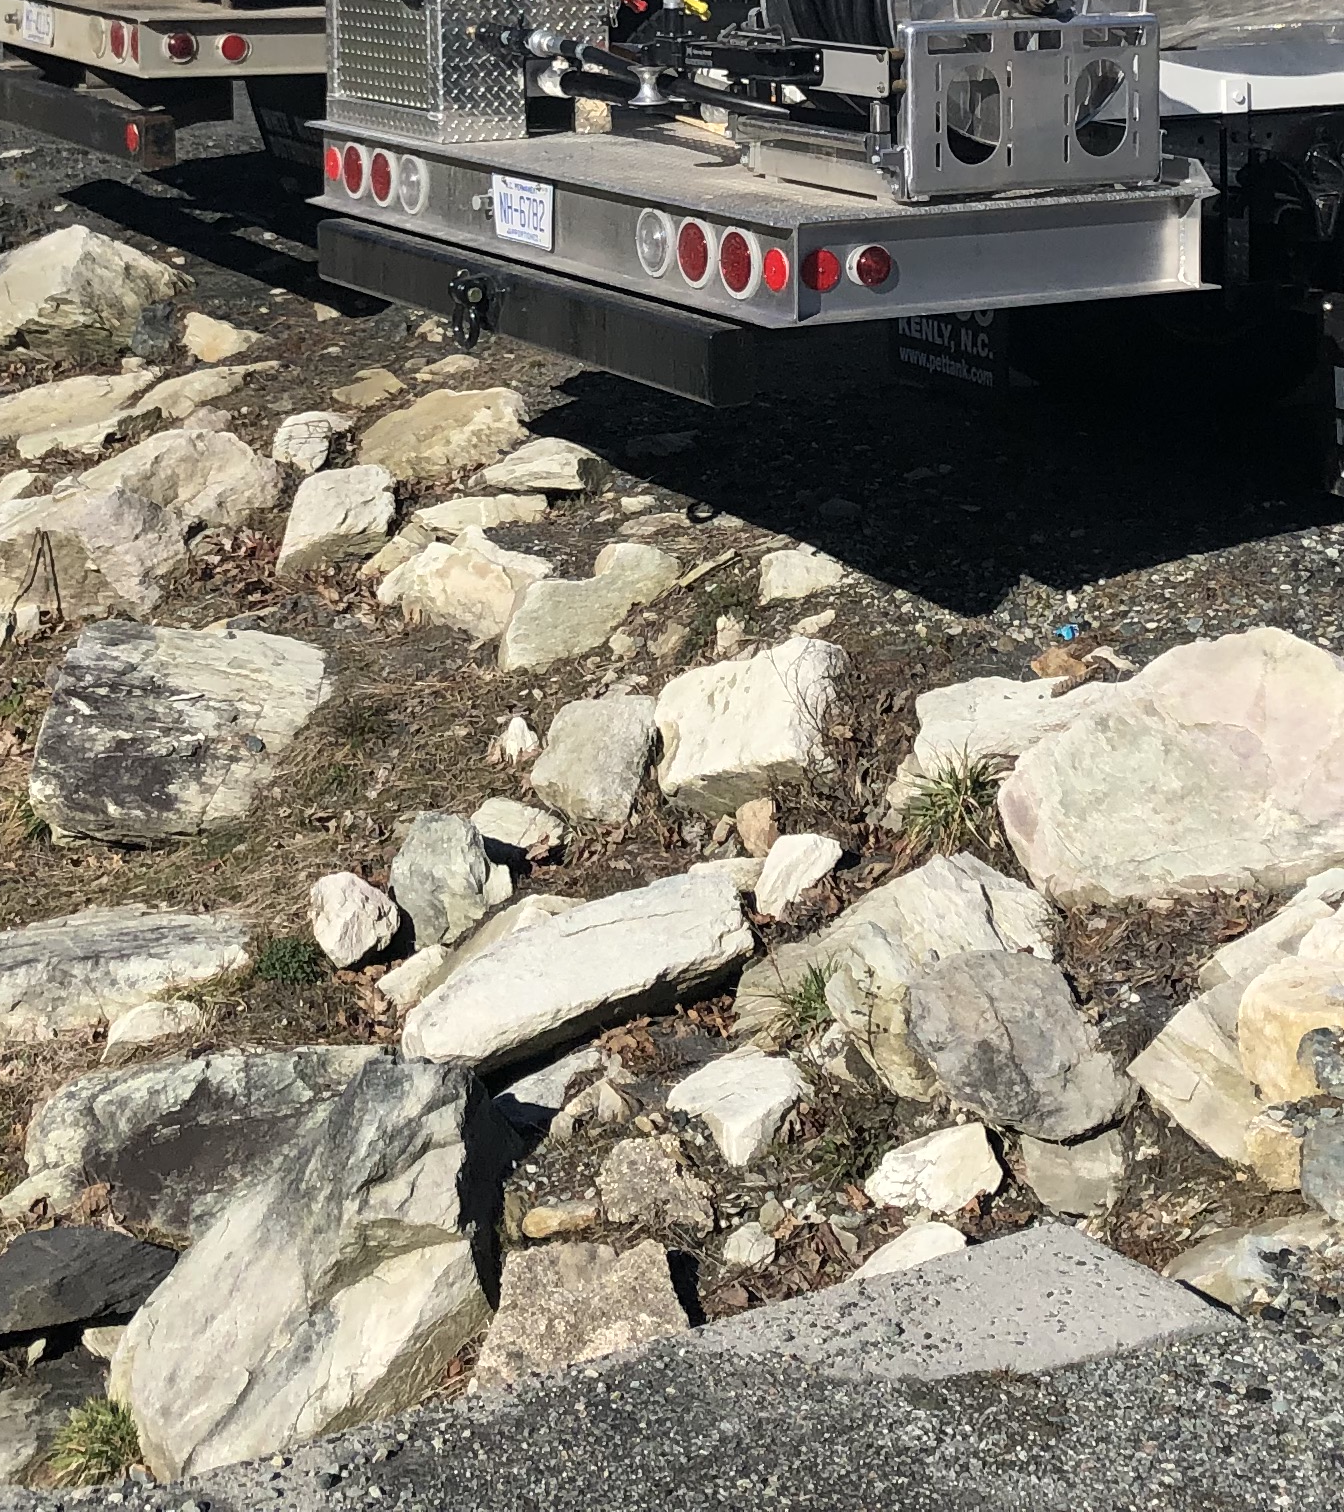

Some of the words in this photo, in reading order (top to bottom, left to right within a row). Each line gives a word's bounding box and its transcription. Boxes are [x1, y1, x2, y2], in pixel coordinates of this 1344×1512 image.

[498, 191, 546, 233] NH-6782
[898, 317, 955, 353] KENLY,
[960, 327, 994, 360] N.C.
[899, 346, 994, 387] www.pettank.com
